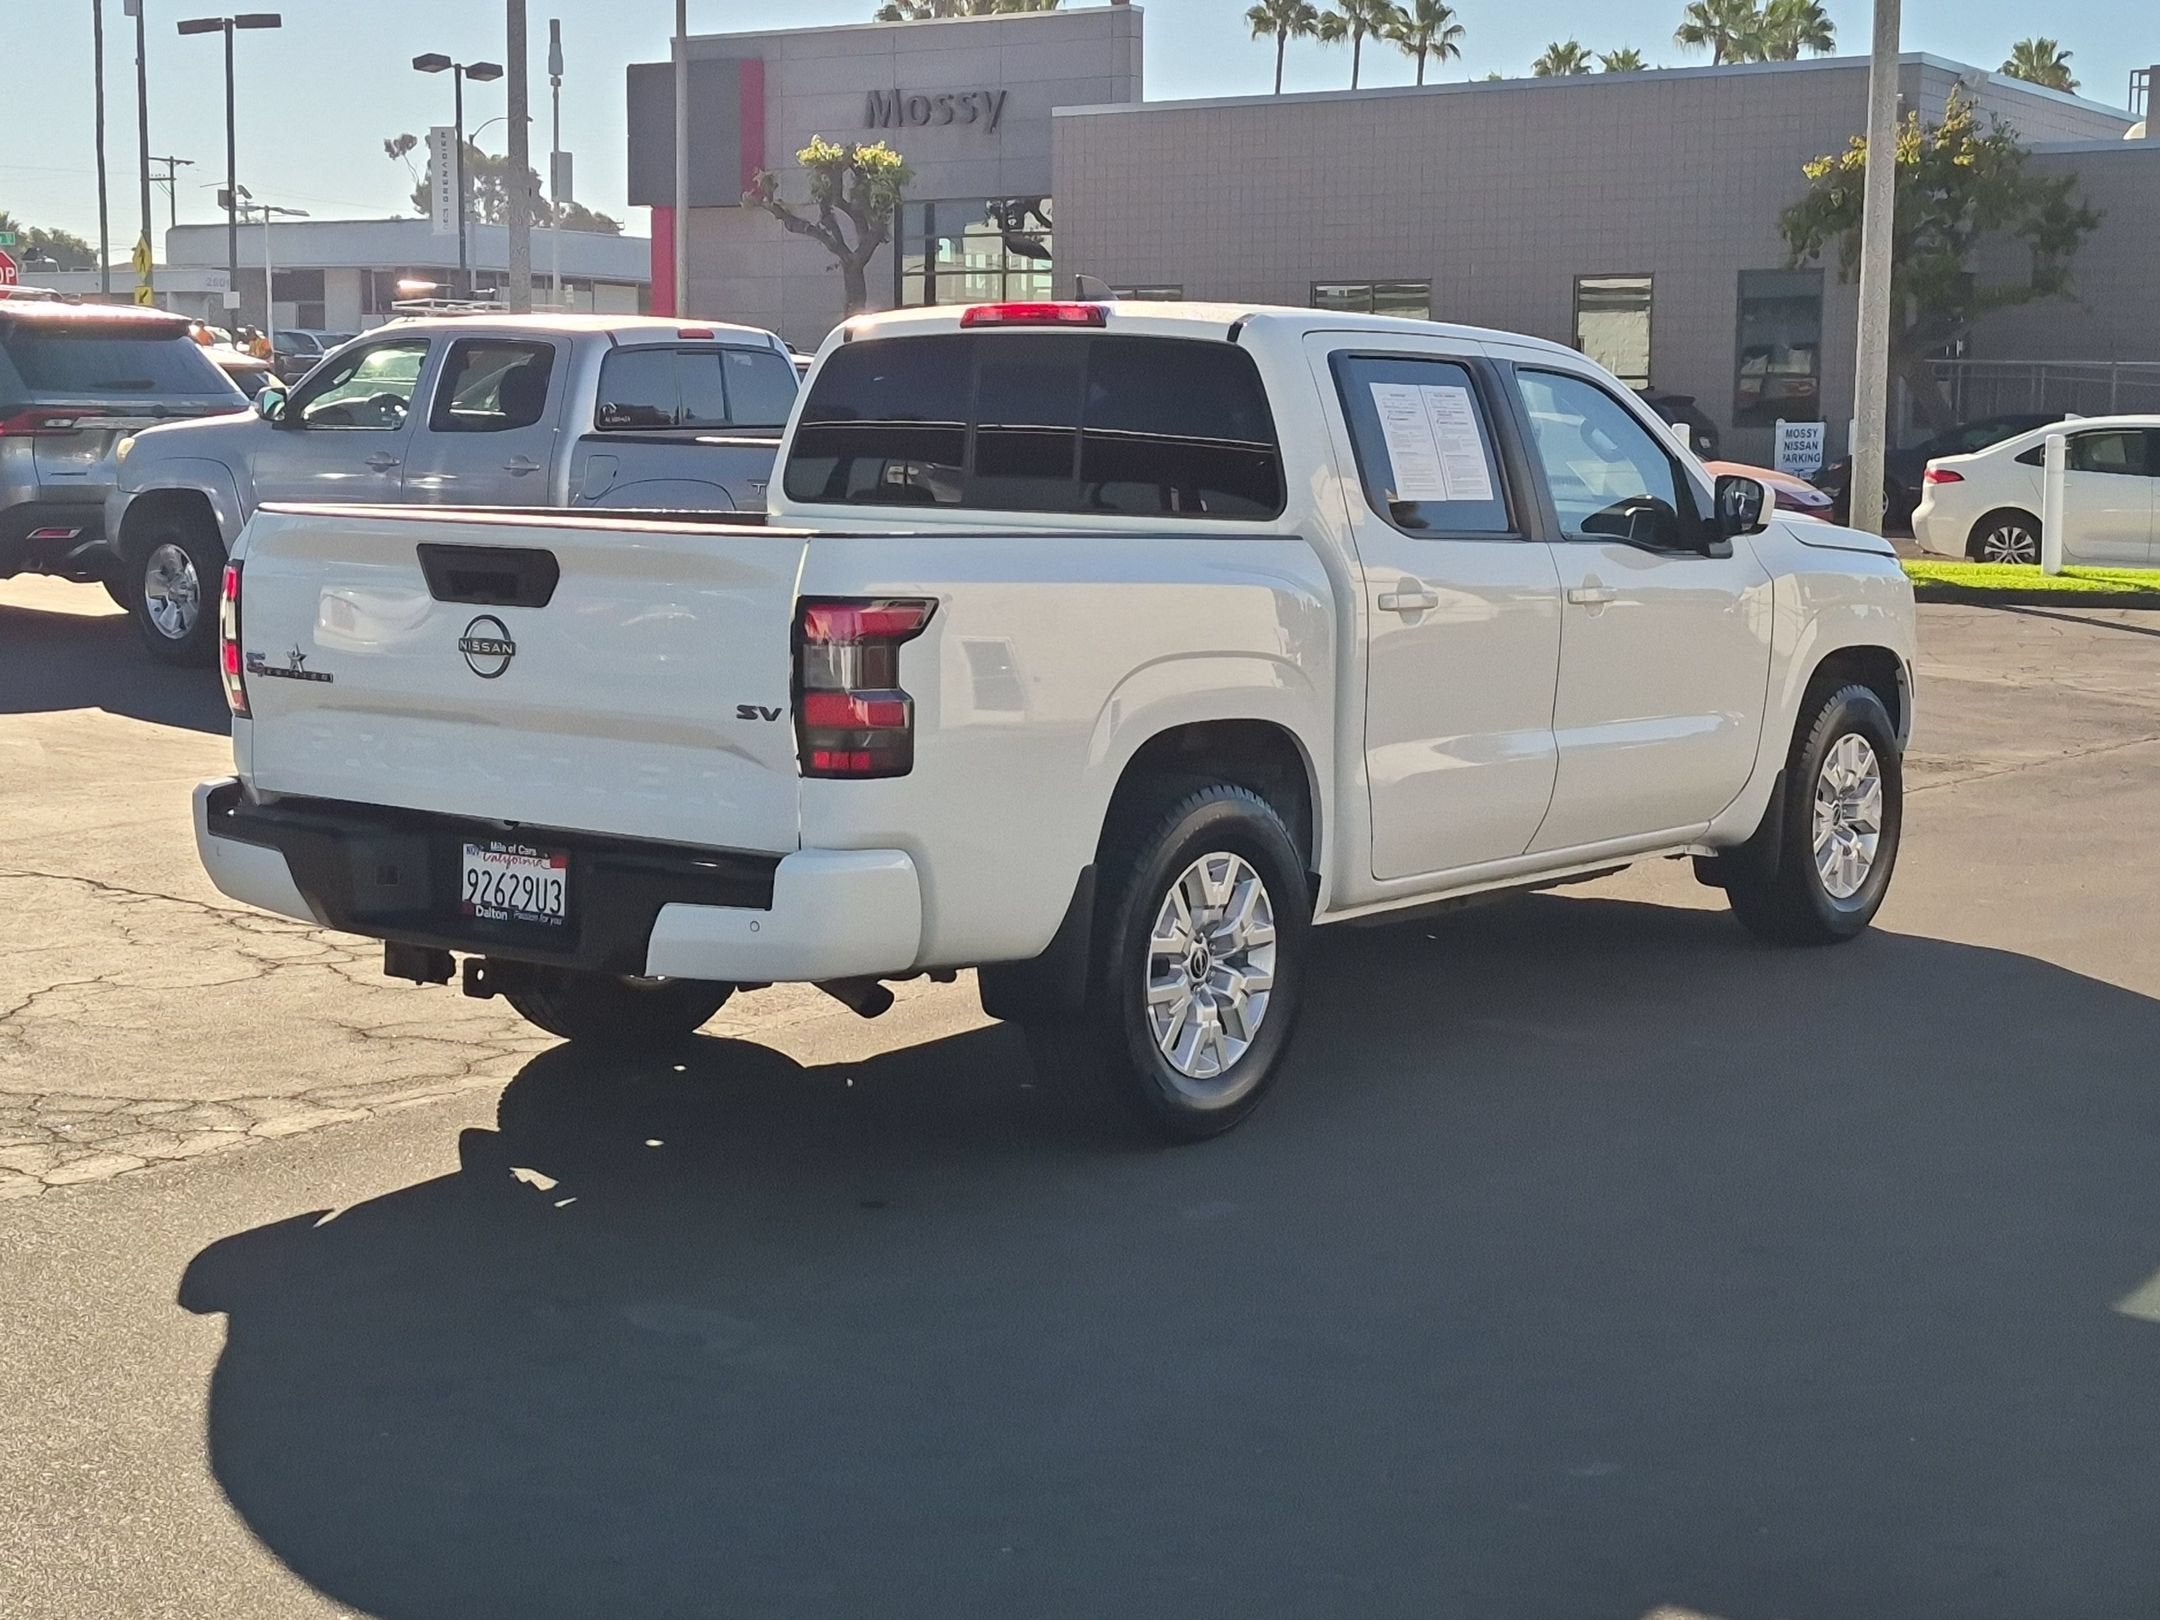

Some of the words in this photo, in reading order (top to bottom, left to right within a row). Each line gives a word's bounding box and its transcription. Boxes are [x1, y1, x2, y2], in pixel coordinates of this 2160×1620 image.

[864, 88, 1008, 134] Mossy
[1786, 428, 1818, 438] MOSSY
[1784, 441, 1818, 450] NISSAN
[459, 639, 514, 654] NISSAN
[736, 704, 783, 722] SV
[490, 841, 507, 853] Mile
[508, 844, 517, 854] of
[518, 845, 537, 856] Cars
[467, 867, 562, 914] 92629U3
[475, 904, 508, 921] Dalton
